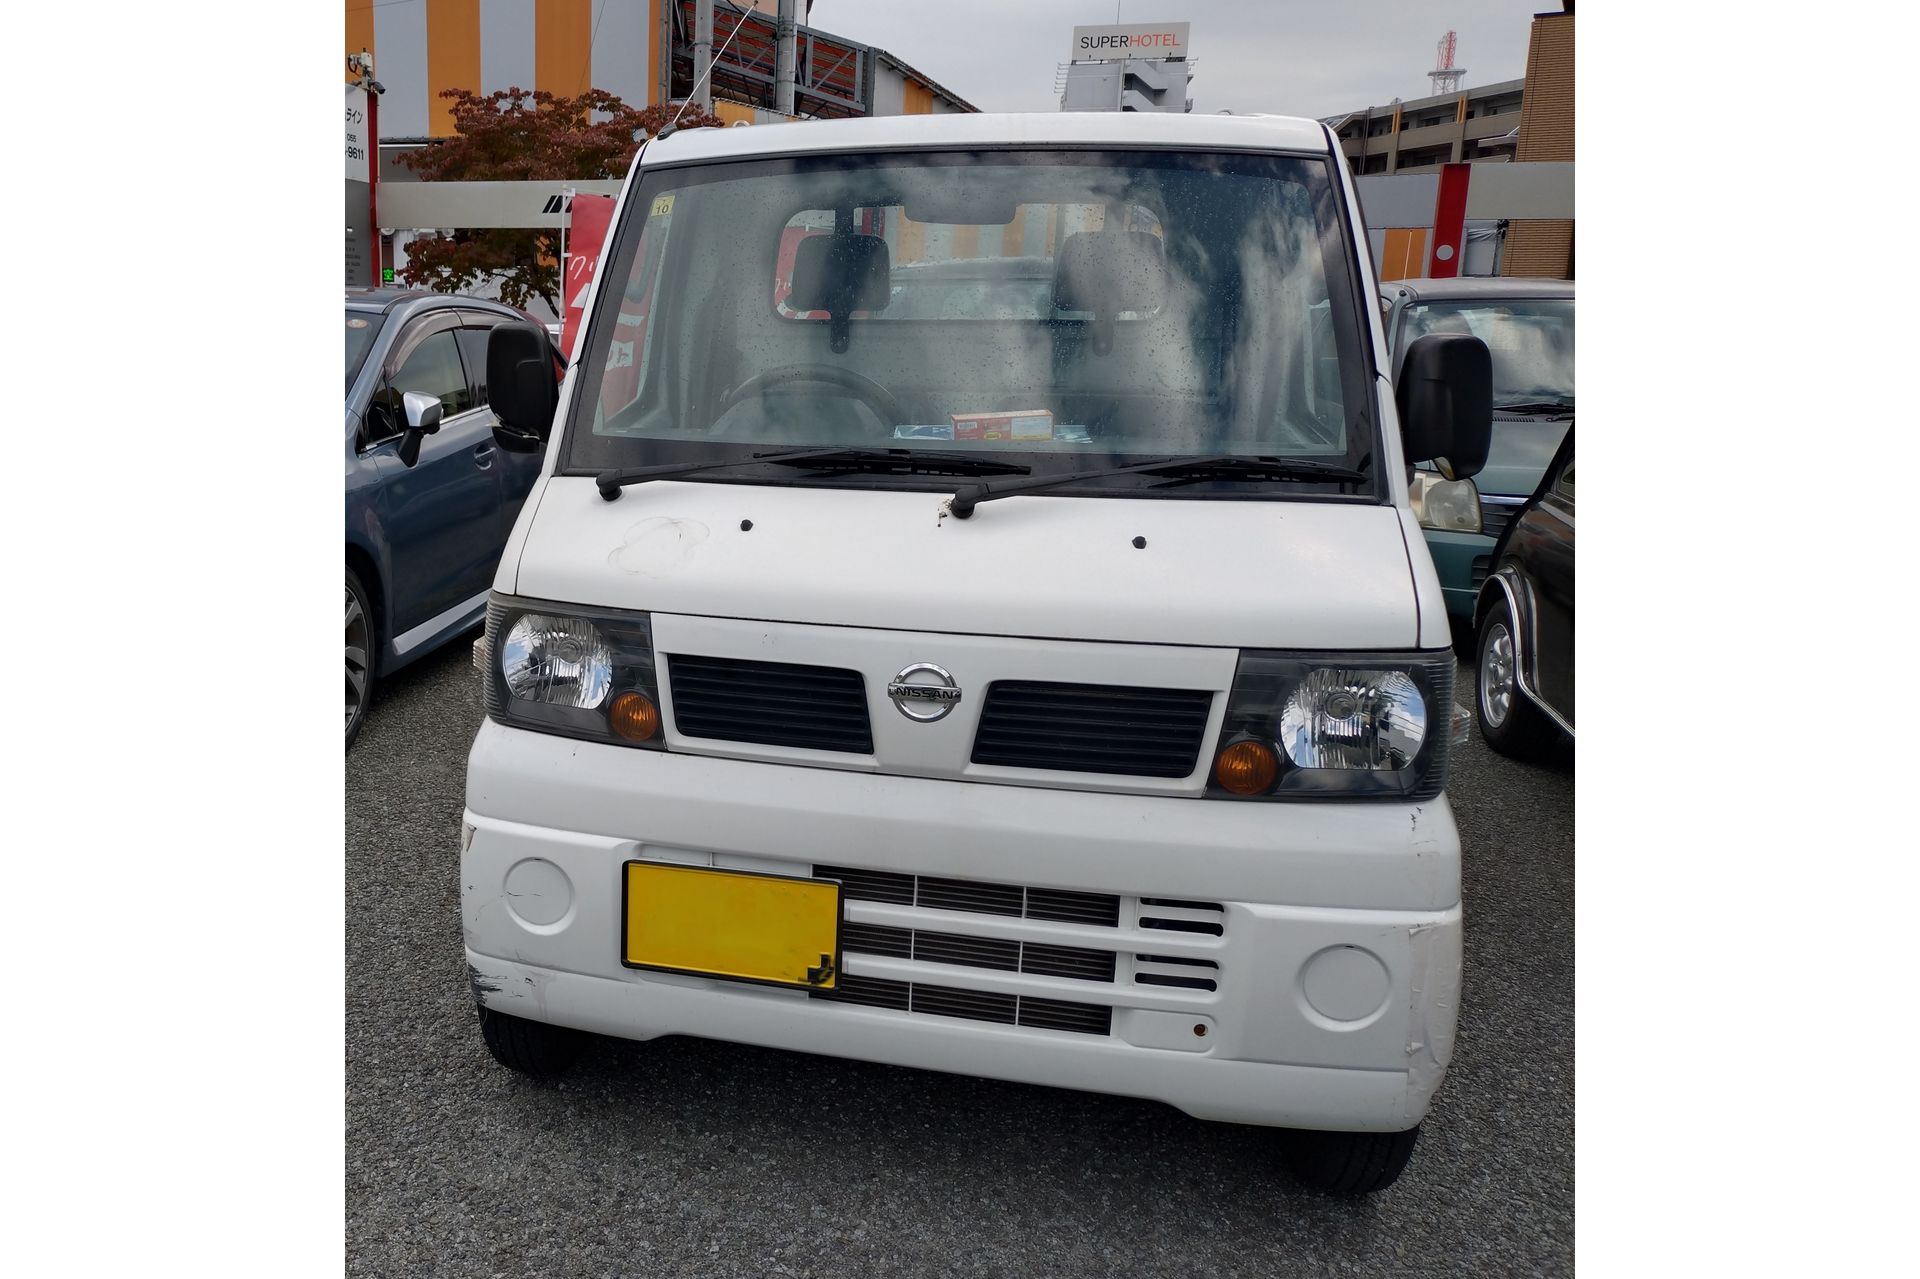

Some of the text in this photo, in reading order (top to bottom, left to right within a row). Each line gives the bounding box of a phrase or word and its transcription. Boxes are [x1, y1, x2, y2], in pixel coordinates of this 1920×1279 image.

[345, 146, 364, 161] -9611
[656, 204, 669, 215] 10
[896, 687, 953, 700] NISSAN
